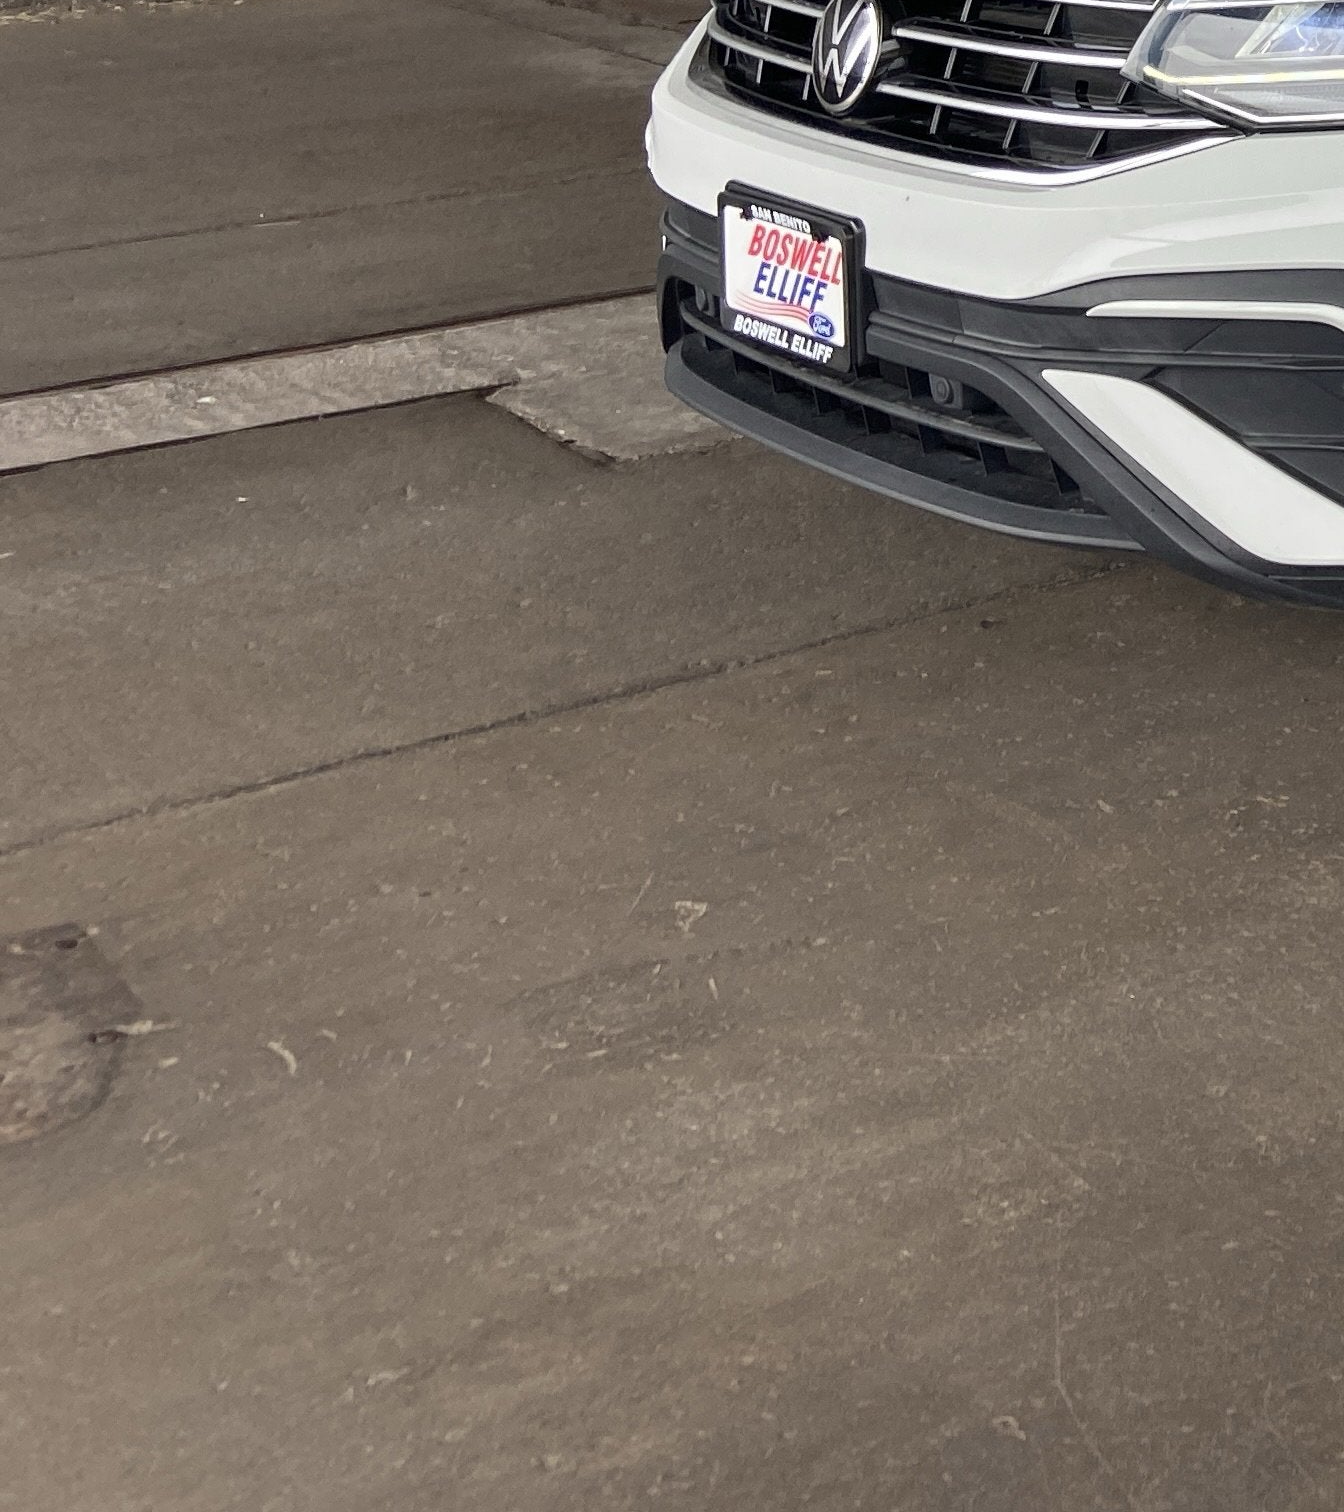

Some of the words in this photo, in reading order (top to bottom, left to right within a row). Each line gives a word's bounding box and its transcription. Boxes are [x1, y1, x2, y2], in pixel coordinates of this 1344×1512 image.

[751, 204, 773, 224] SAN
[773, 210, 811, 234] BENITO
[747, 223, 843, 286] BOSWELL
[753, 261, 828, 314] ELLIFF
[733, 313, 790, 349] BOSWELL
[792, 334, 834, 364] ELLIFF
[812, 316, 833, 338] Ford
